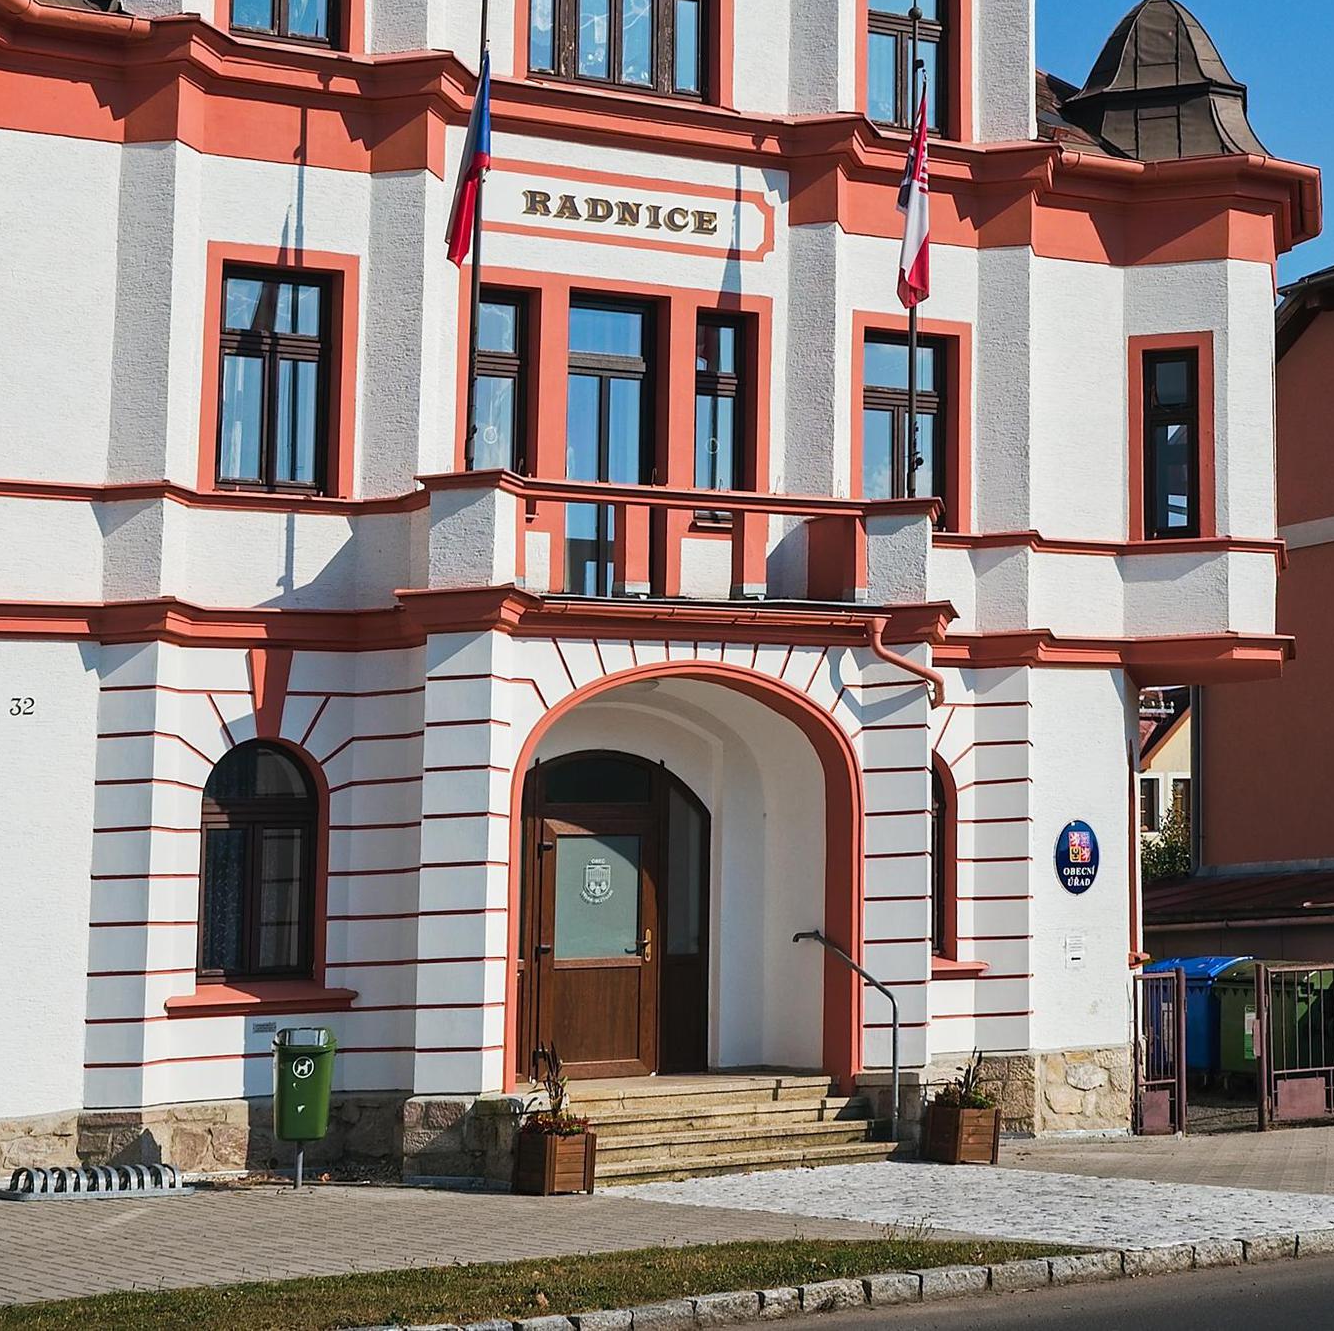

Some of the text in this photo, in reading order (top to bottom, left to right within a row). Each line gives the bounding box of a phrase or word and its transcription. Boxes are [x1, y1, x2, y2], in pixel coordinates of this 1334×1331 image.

[522, 189, 718, 235] RADNICE
[9, 697, 36, 716] 32
[1063, 865, 1096, 876] OBECNÍ
[1067, 876, 1091, 886] ÚŘAD
